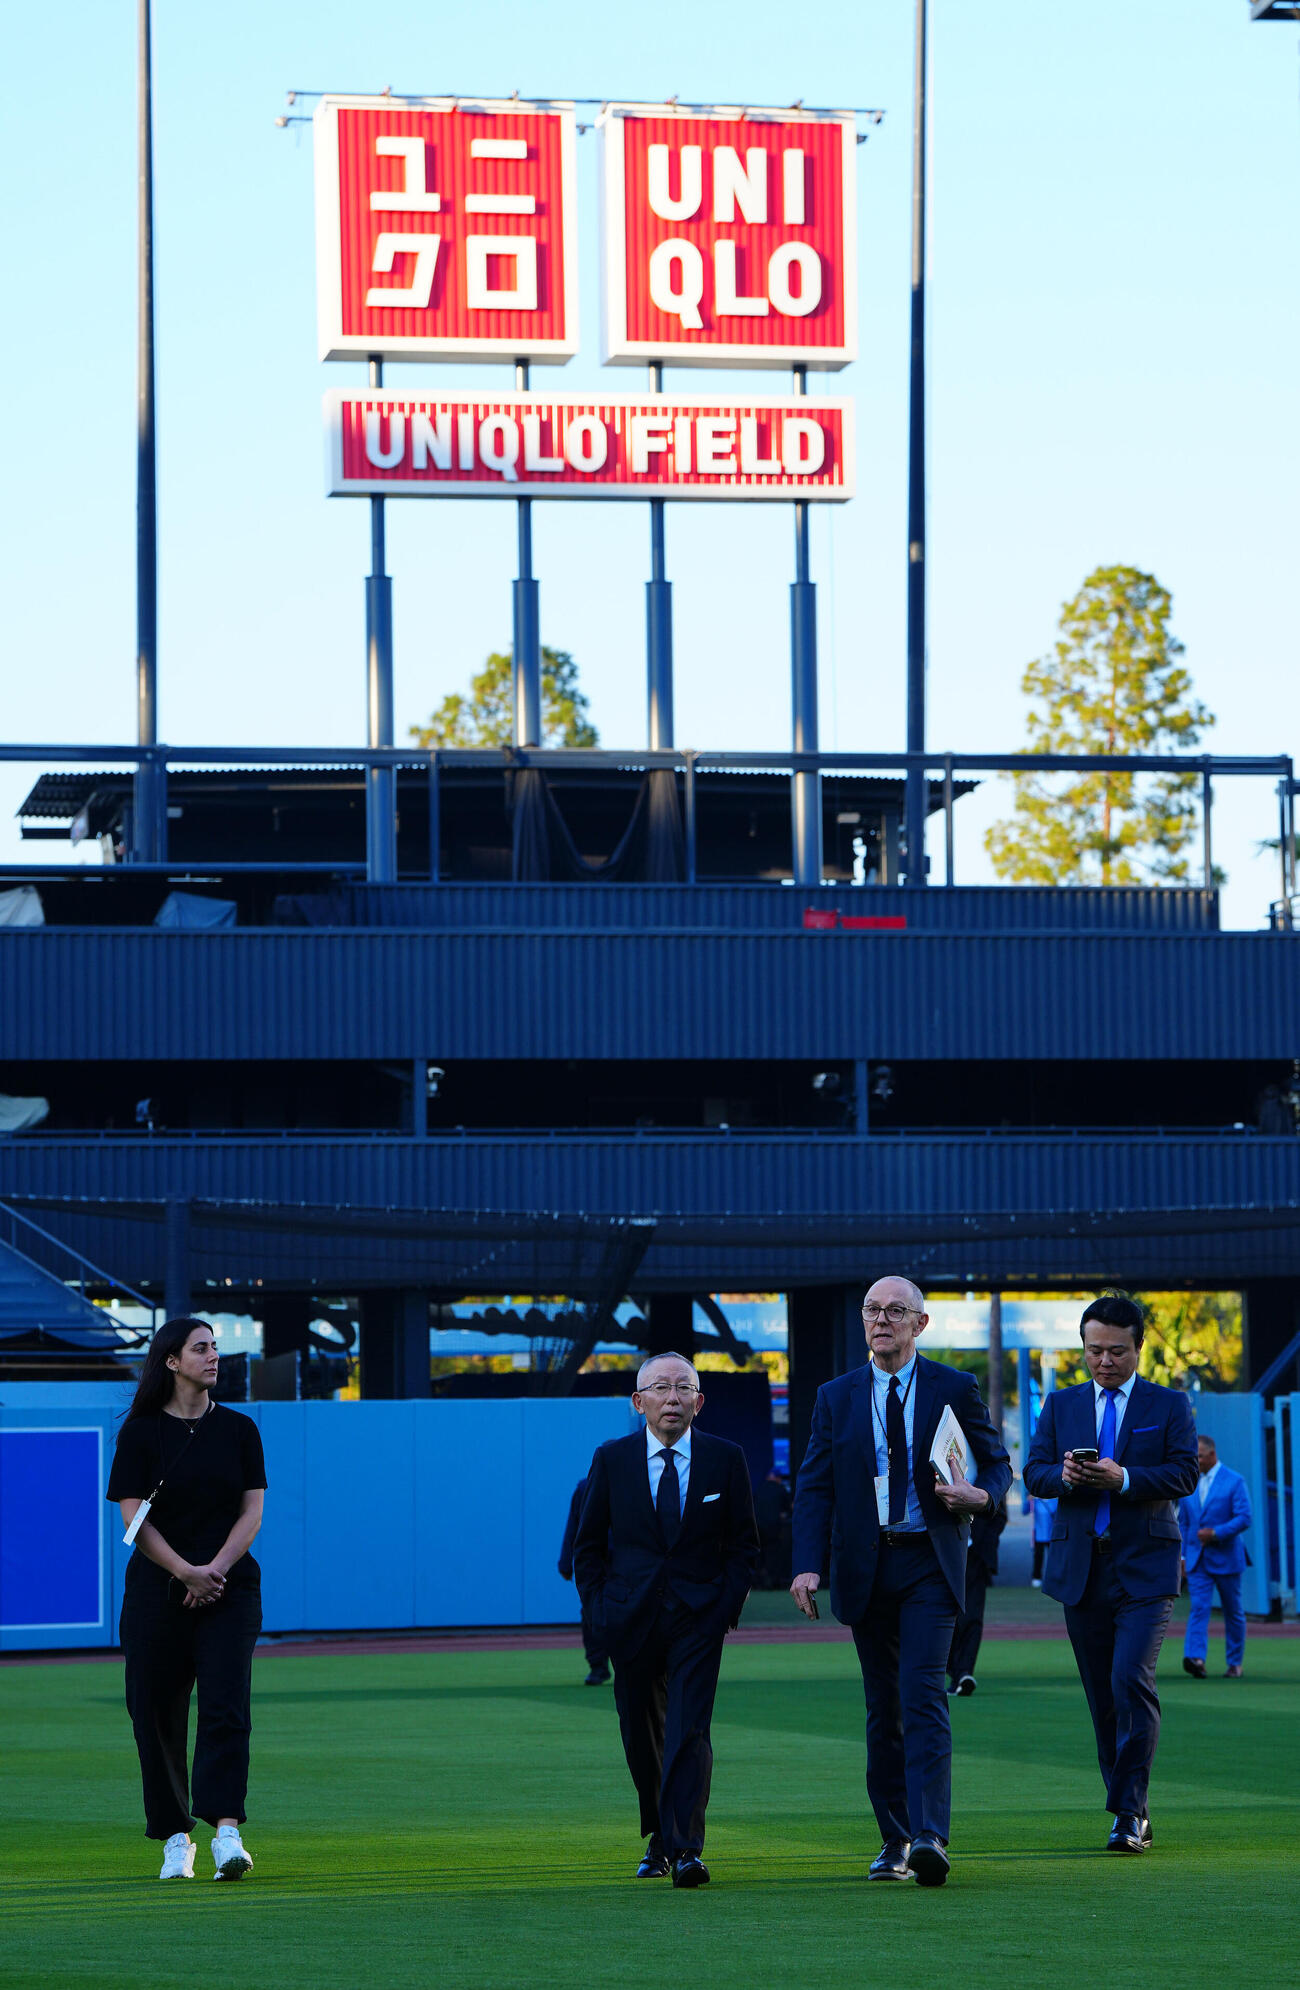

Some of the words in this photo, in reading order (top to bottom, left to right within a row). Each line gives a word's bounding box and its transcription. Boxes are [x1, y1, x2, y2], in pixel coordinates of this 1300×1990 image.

[647, 143, 806, 225] UNI
[649, 237, 823, 330] QLO
[365, 412, 608, 483] UNIQLO
[632, 415, 826, 476] FIELD
